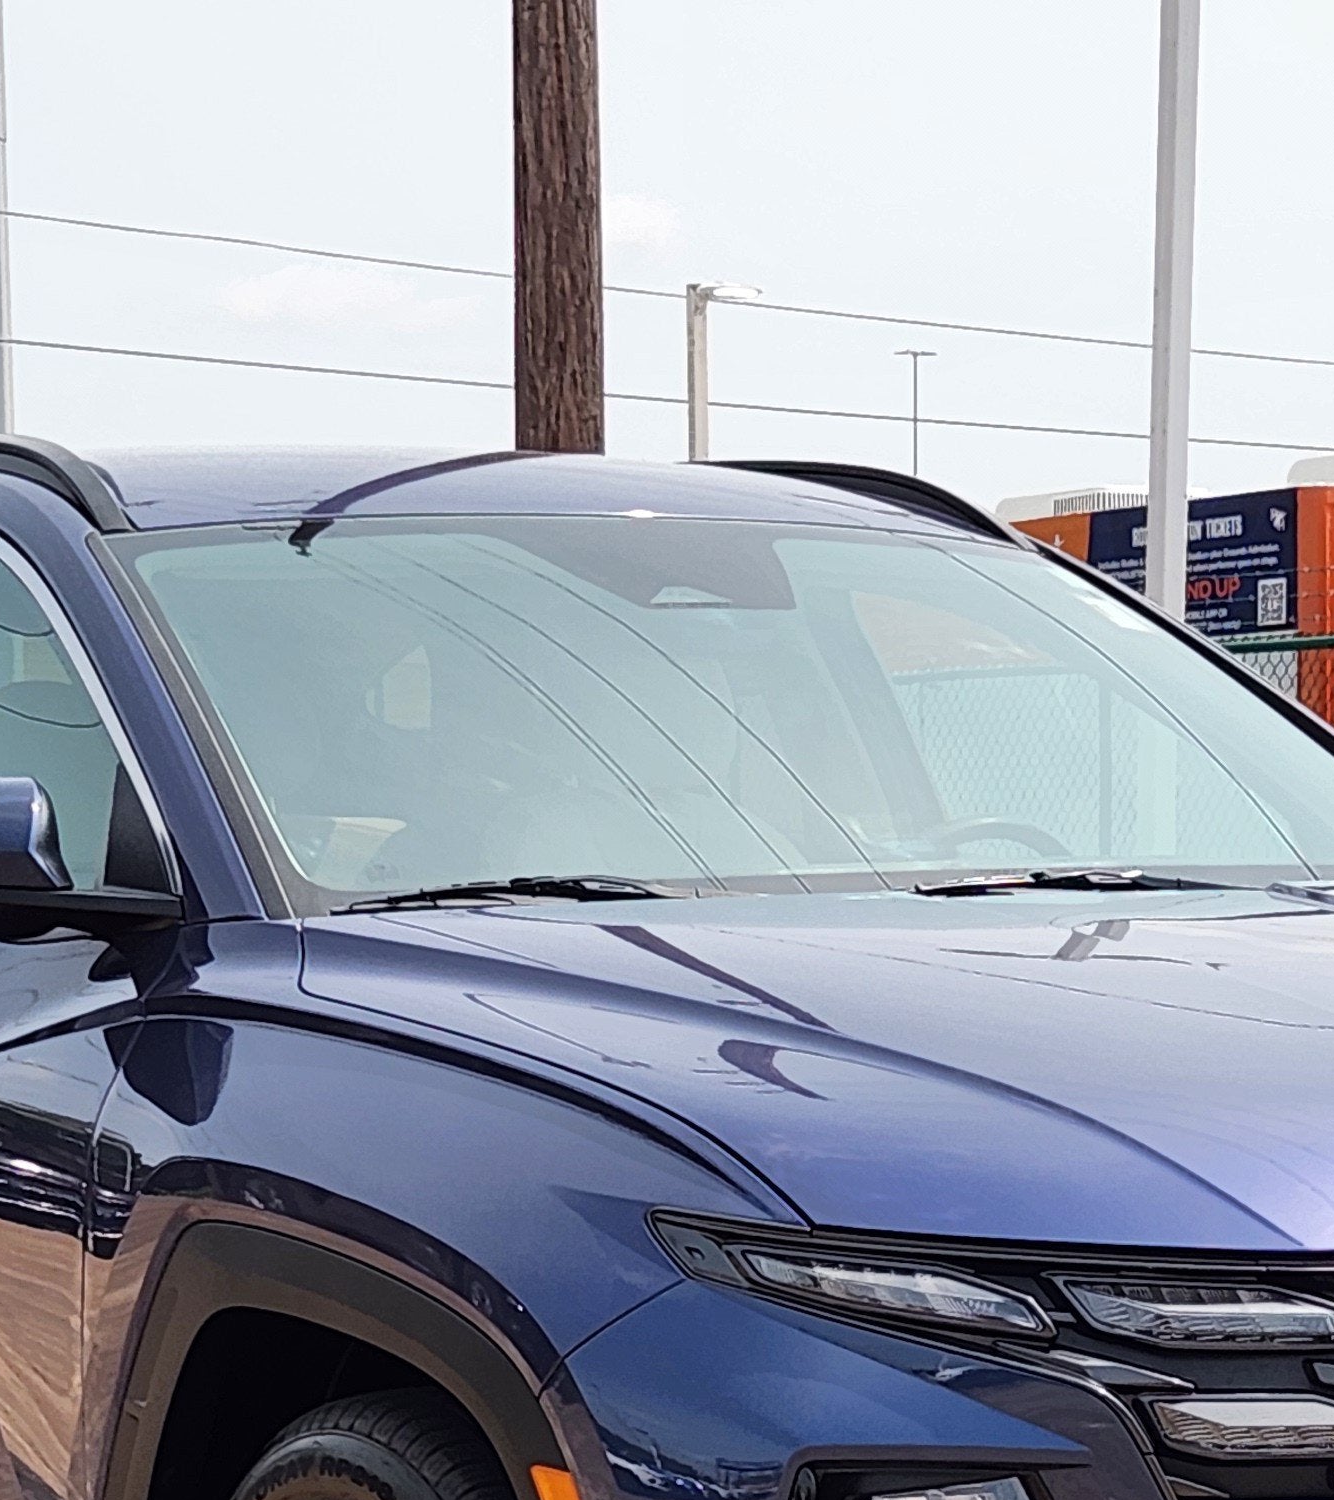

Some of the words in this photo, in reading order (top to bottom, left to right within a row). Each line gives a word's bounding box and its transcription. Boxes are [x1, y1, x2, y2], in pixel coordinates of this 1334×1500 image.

[1205, 515, 1243, 539] TICKETS
[1187, 579, 1212, 600] ND
[1216, 576, 1241, 597] UP
